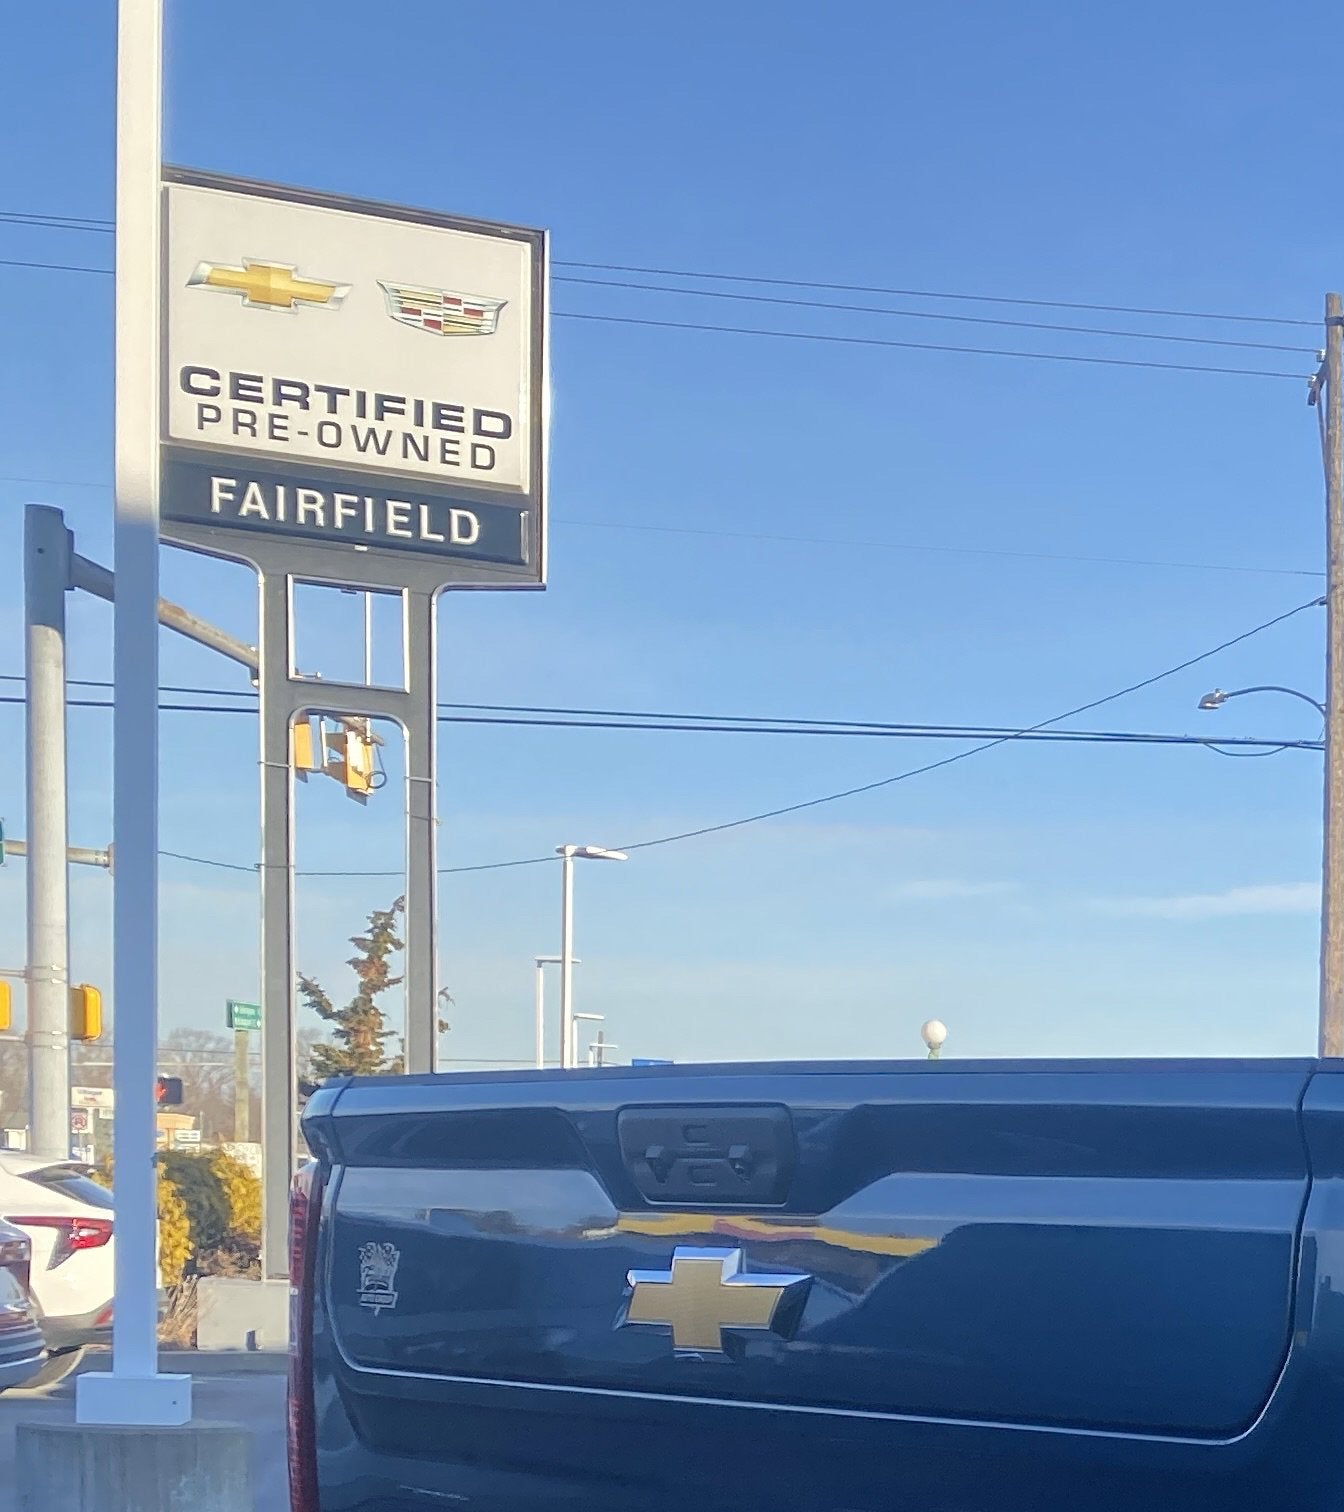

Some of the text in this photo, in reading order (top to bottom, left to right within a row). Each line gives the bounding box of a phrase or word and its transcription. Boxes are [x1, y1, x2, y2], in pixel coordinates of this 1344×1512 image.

[180, 365, 512, 440] CERTIFIED
[197, 402, 496, 471] PRE-OWNED
[210, 476, 481, 546] FAIRFIELD
